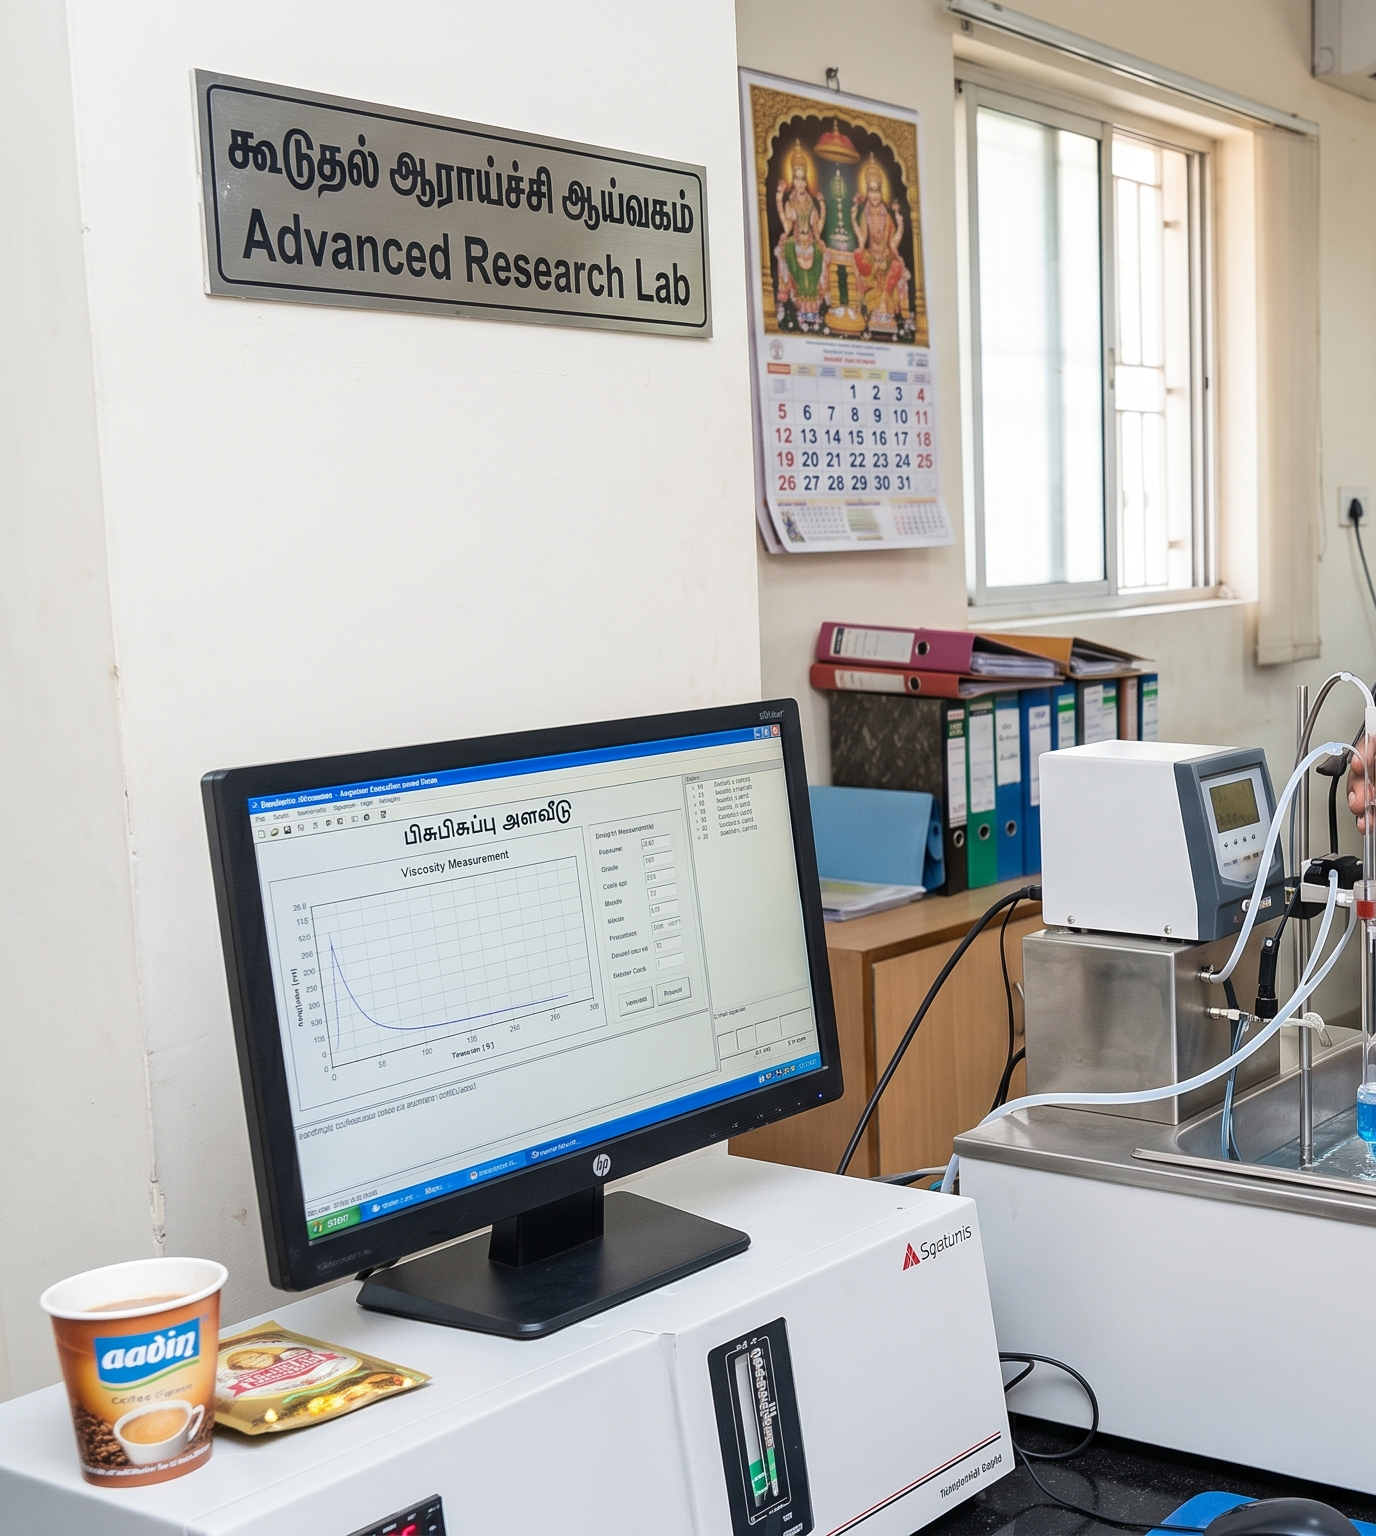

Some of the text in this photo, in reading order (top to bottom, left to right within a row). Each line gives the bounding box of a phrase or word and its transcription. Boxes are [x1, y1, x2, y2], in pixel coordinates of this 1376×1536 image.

[228, 128, 695, 235] கூடுதல் ஆராய்ச்சி ஆய்வகம்
[242, 207, 692, 307] Advanced Research Lab
[850, 384, 925, 402] 1 2 3 4
[778, 403, 928, 425] 5 6 7 8 9 10 11
[775, 427, 932, 447] 12 13 14 15 16 17 18
[776, 451, 933, 469] 19 20 21 22 23 24 25
[778, 474, 911, 491] 26 27 28 29 30 31
[404, 799, 572, 846] பிசுபிசுப்பு அளவீடு
[400, 849, 510, 878] Viscosity Measurement
[331, 1073, 337, 1081] 0
[595, 1153, 611, 1177] hp
